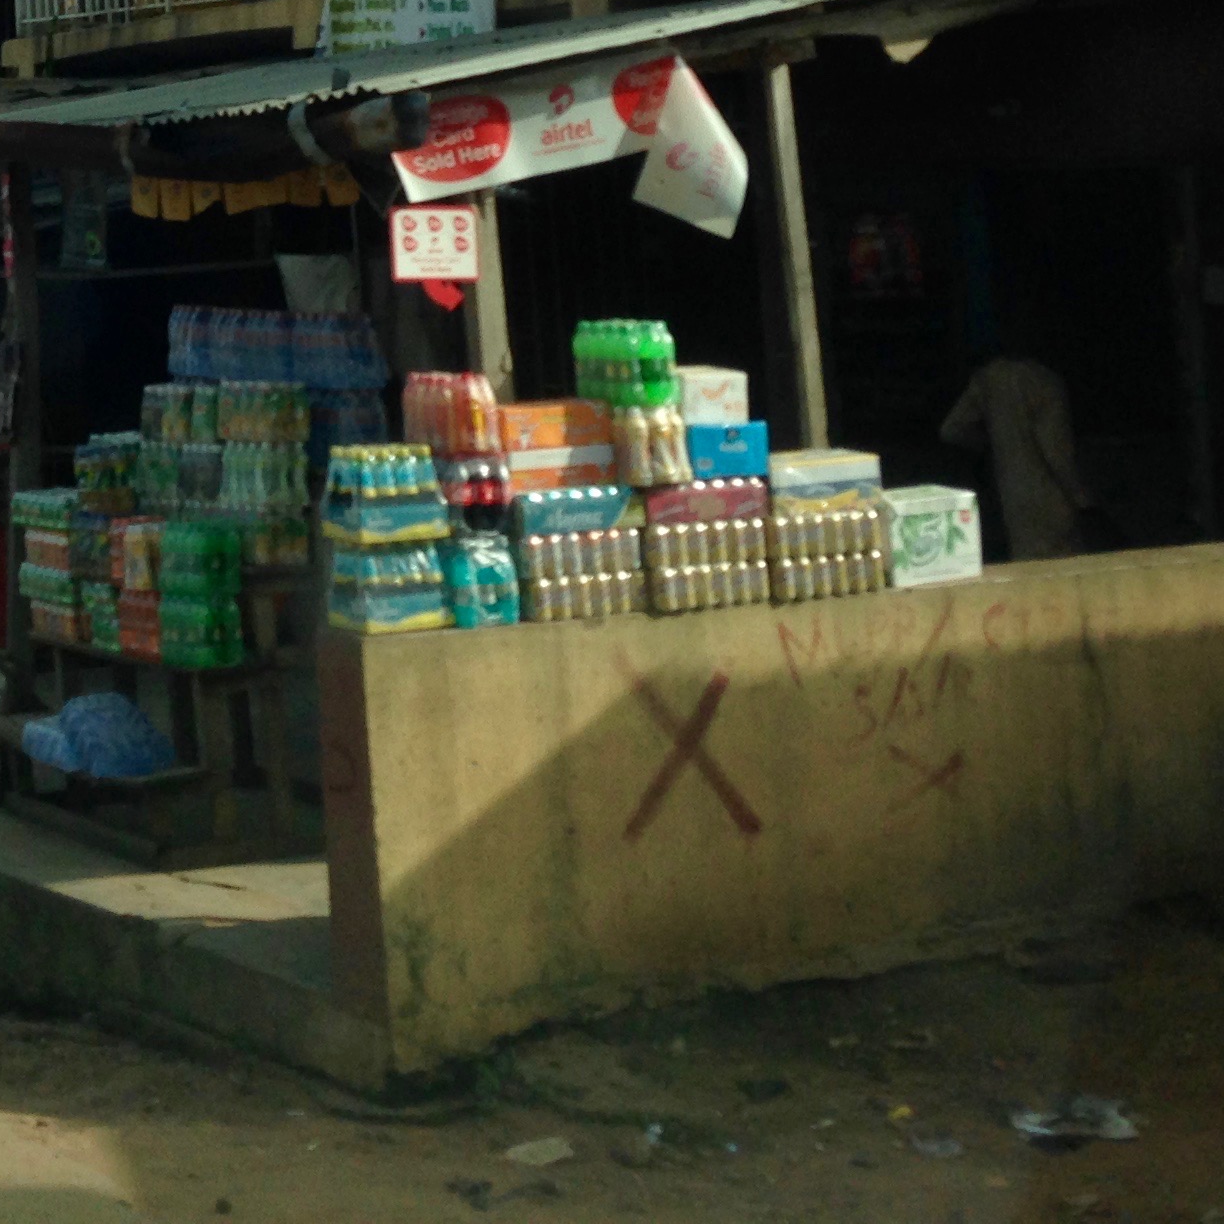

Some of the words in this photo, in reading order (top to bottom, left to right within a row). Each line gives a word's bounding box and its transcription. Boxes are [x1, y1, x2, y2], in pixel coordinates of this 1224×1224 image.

[541, 118, 594, 147] airtel
[414, 149, 456, 175] Sold
[458, 142, 501, 166] Here
